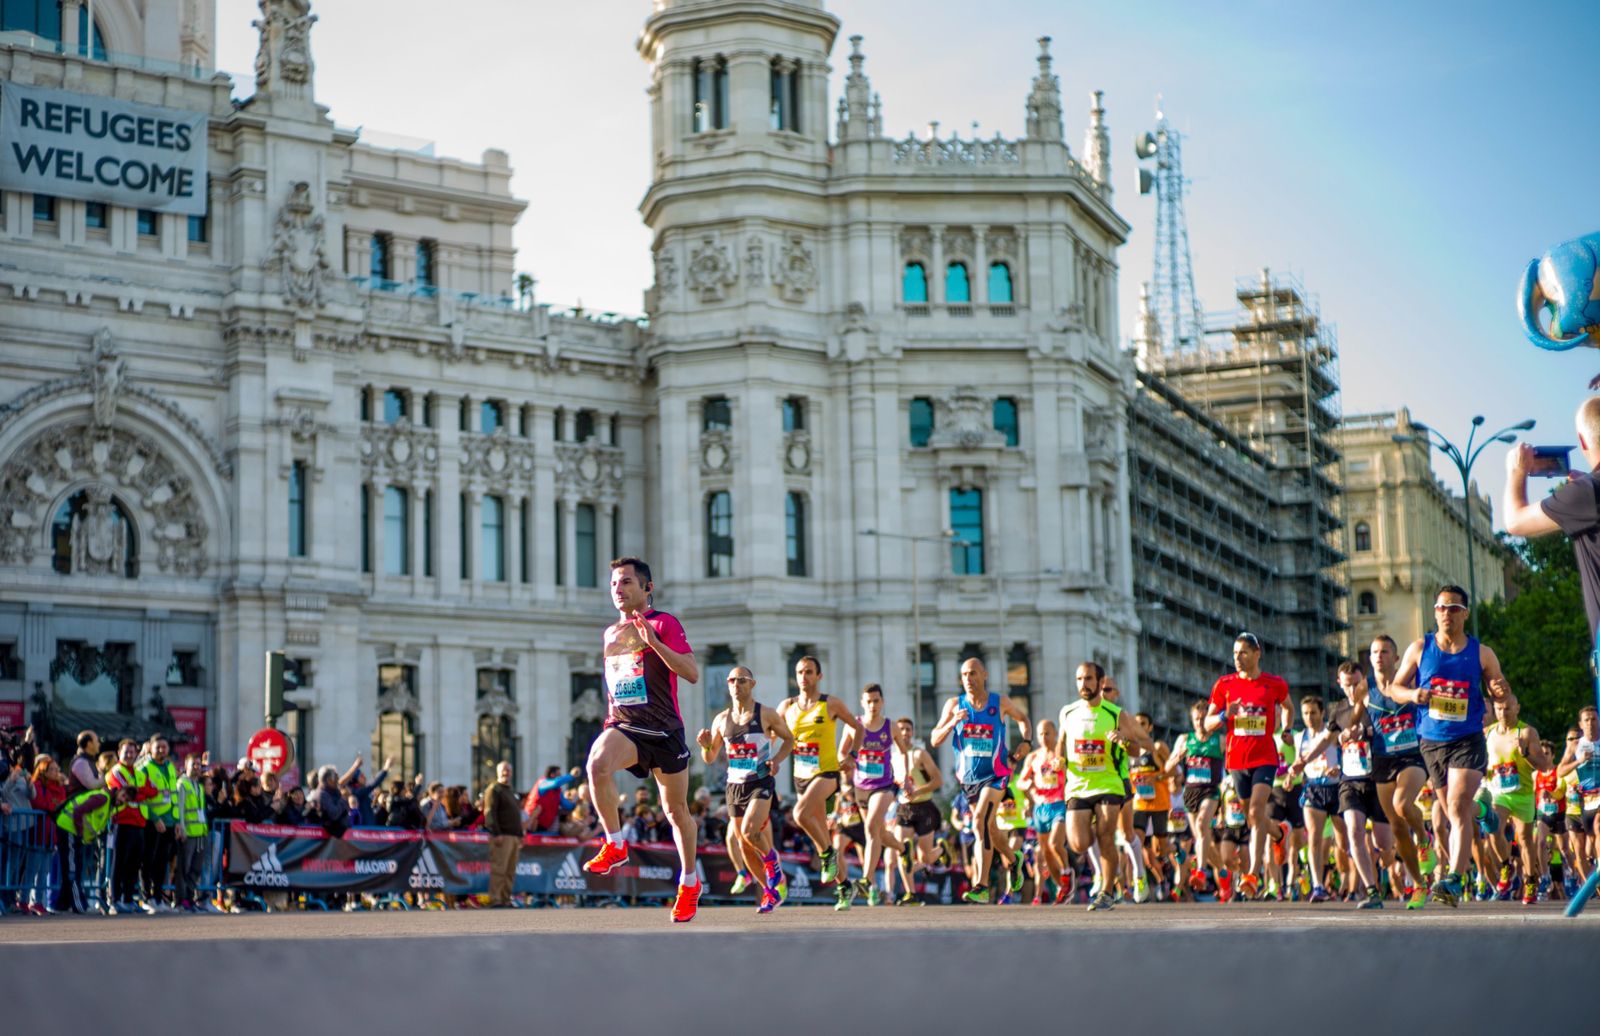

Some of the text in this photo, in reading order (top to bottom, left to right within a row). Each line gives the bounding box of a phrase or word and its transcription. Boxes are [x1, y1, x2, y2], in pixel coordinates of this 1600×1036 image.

[20, 97, 192, 152] REFUGEES
[11, 141, 194, 198] WELCOME
[354, 859, 398, 874] MADRID
[243, 870, 290, 887] adidas
[408, 873, 445, 889] adidas
